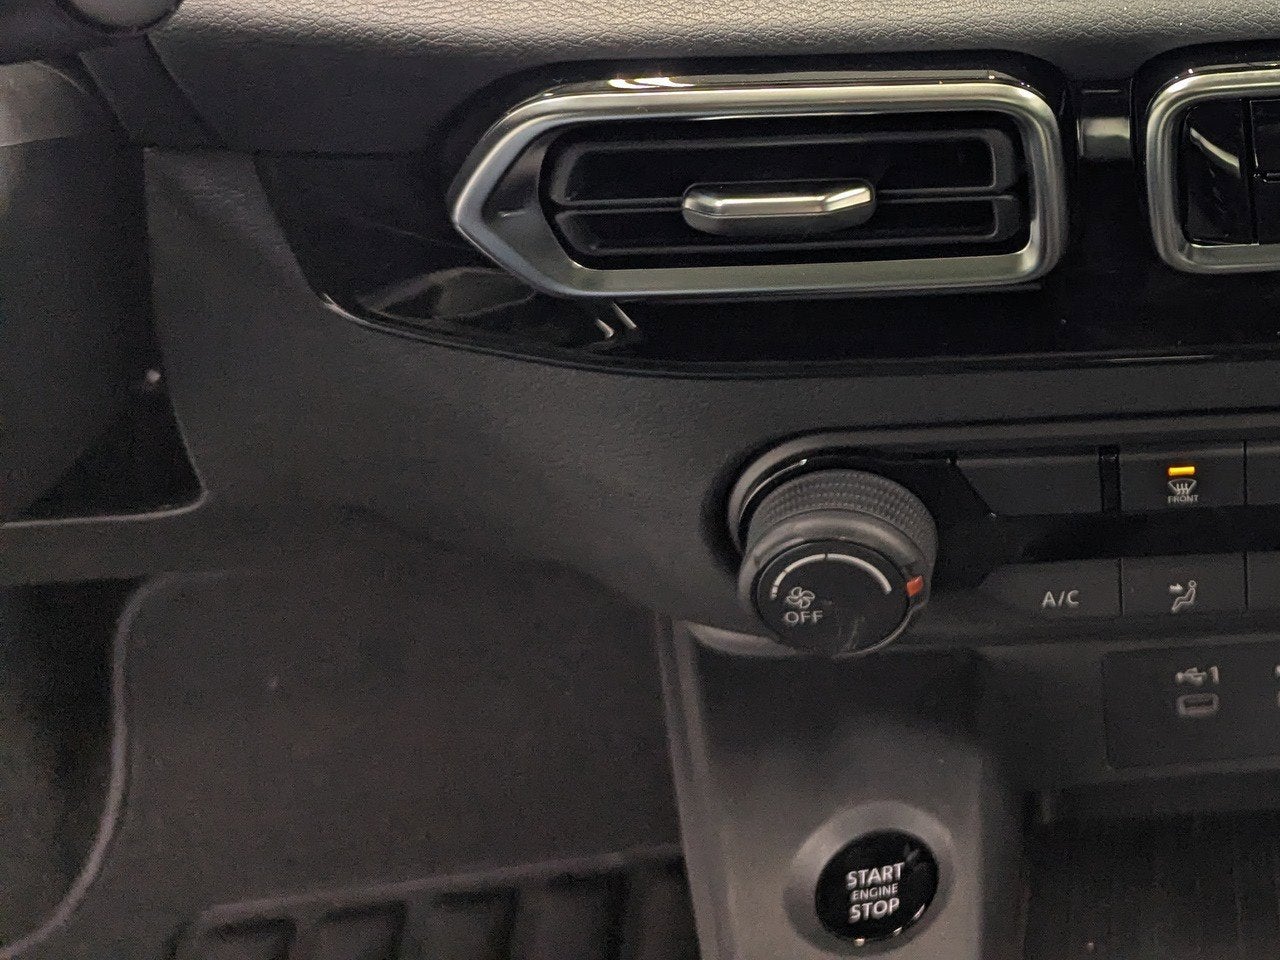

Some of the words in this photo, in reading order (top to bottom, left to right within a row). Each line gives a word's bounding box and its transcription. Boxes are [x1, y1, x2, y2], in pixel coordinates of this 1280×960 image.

[1167, 493, 1199, 504] FRONT
[1041, 589, 1080, 609] A/C
[783, 610, 824, 627] OFF
[845, 861, 906, 890] START
[851, 882, 899, 902] ENGINE
[848, 896, 900, 924] STOP
